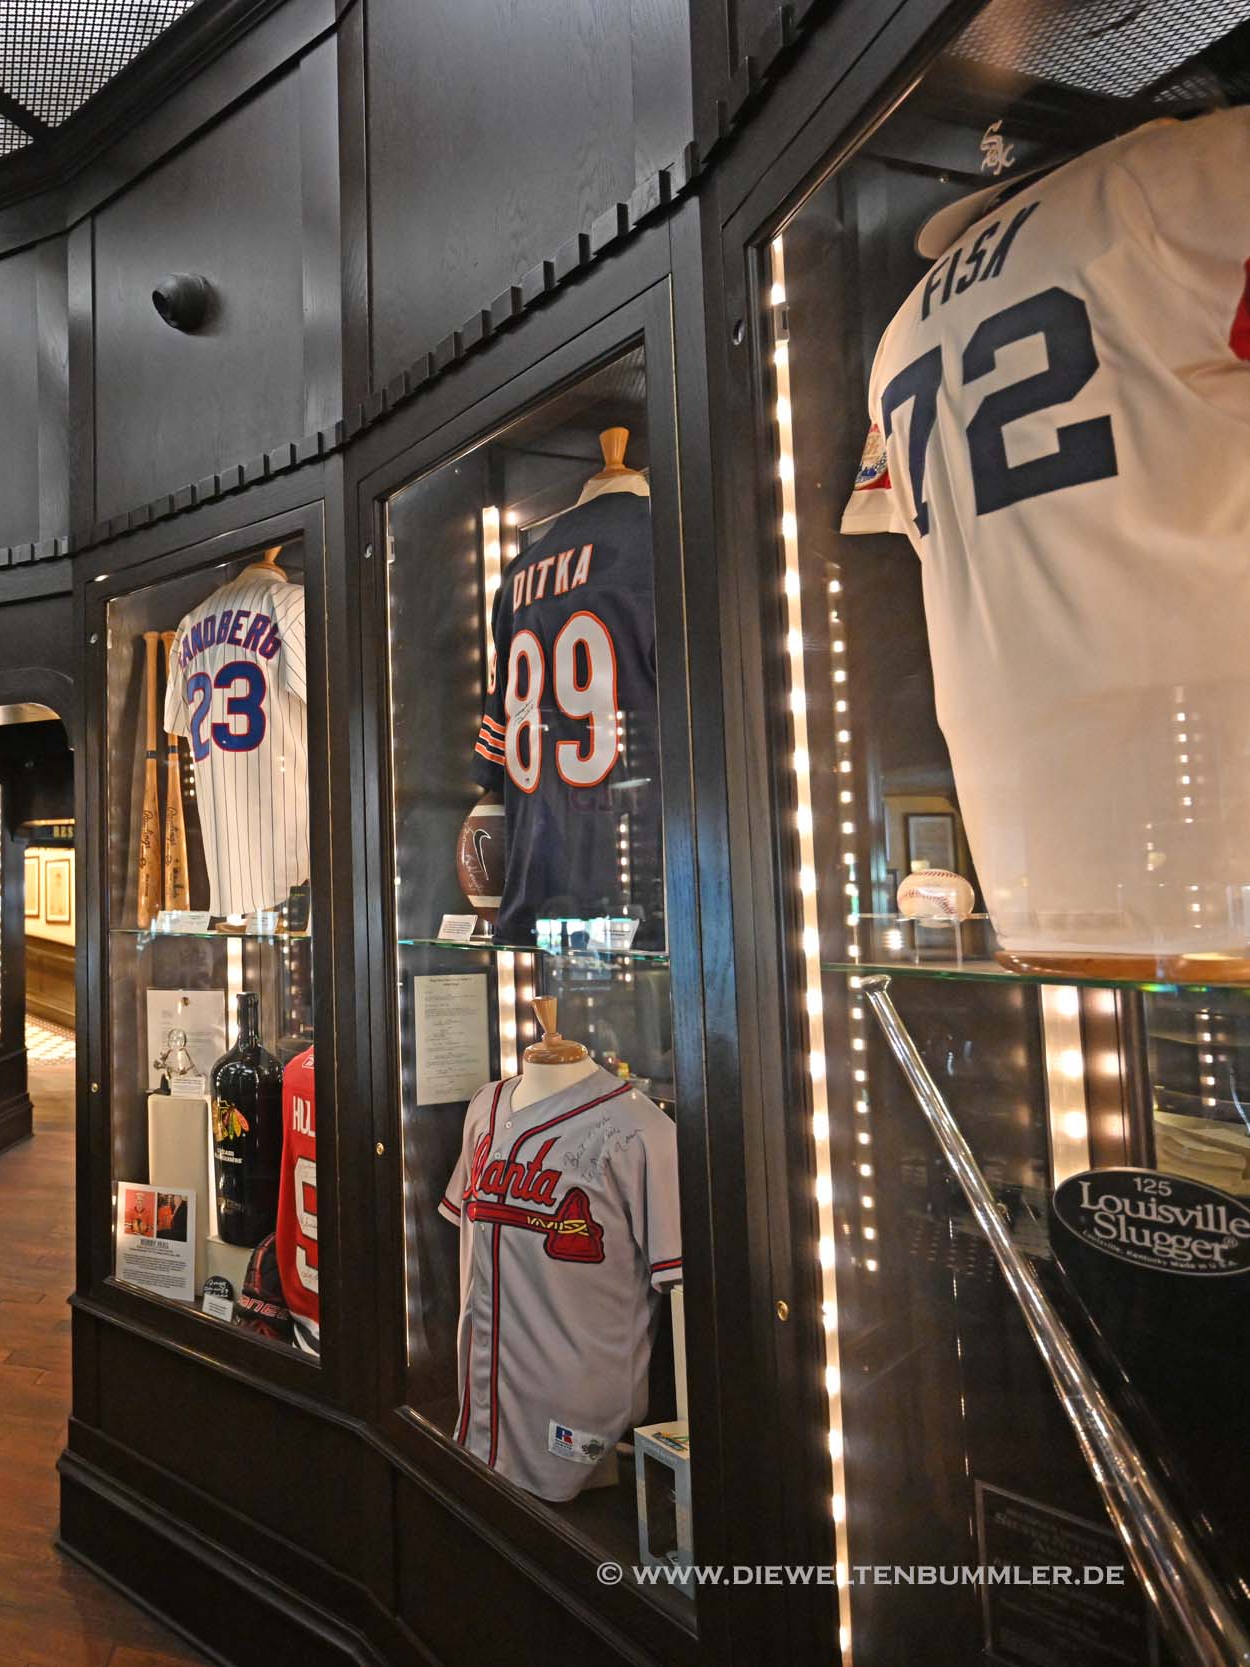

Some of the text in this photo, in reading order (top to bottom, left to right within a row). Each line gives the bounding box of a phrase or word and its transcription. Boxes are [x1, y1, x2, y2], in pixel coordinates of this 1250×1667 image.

[920, 201, 1041, 322] FISK
[881, 286, 1119, 538] 72
[512, 543, 594, 614] DITKA
[179, 609, 282, 669] ANDBERG
[187, 660, 267, 763] 23
[504, 611, 620, 794] 89
[1078, 1180, 1250, 1239] Louisville
[1133, 1177, 1172, 1197] 125
